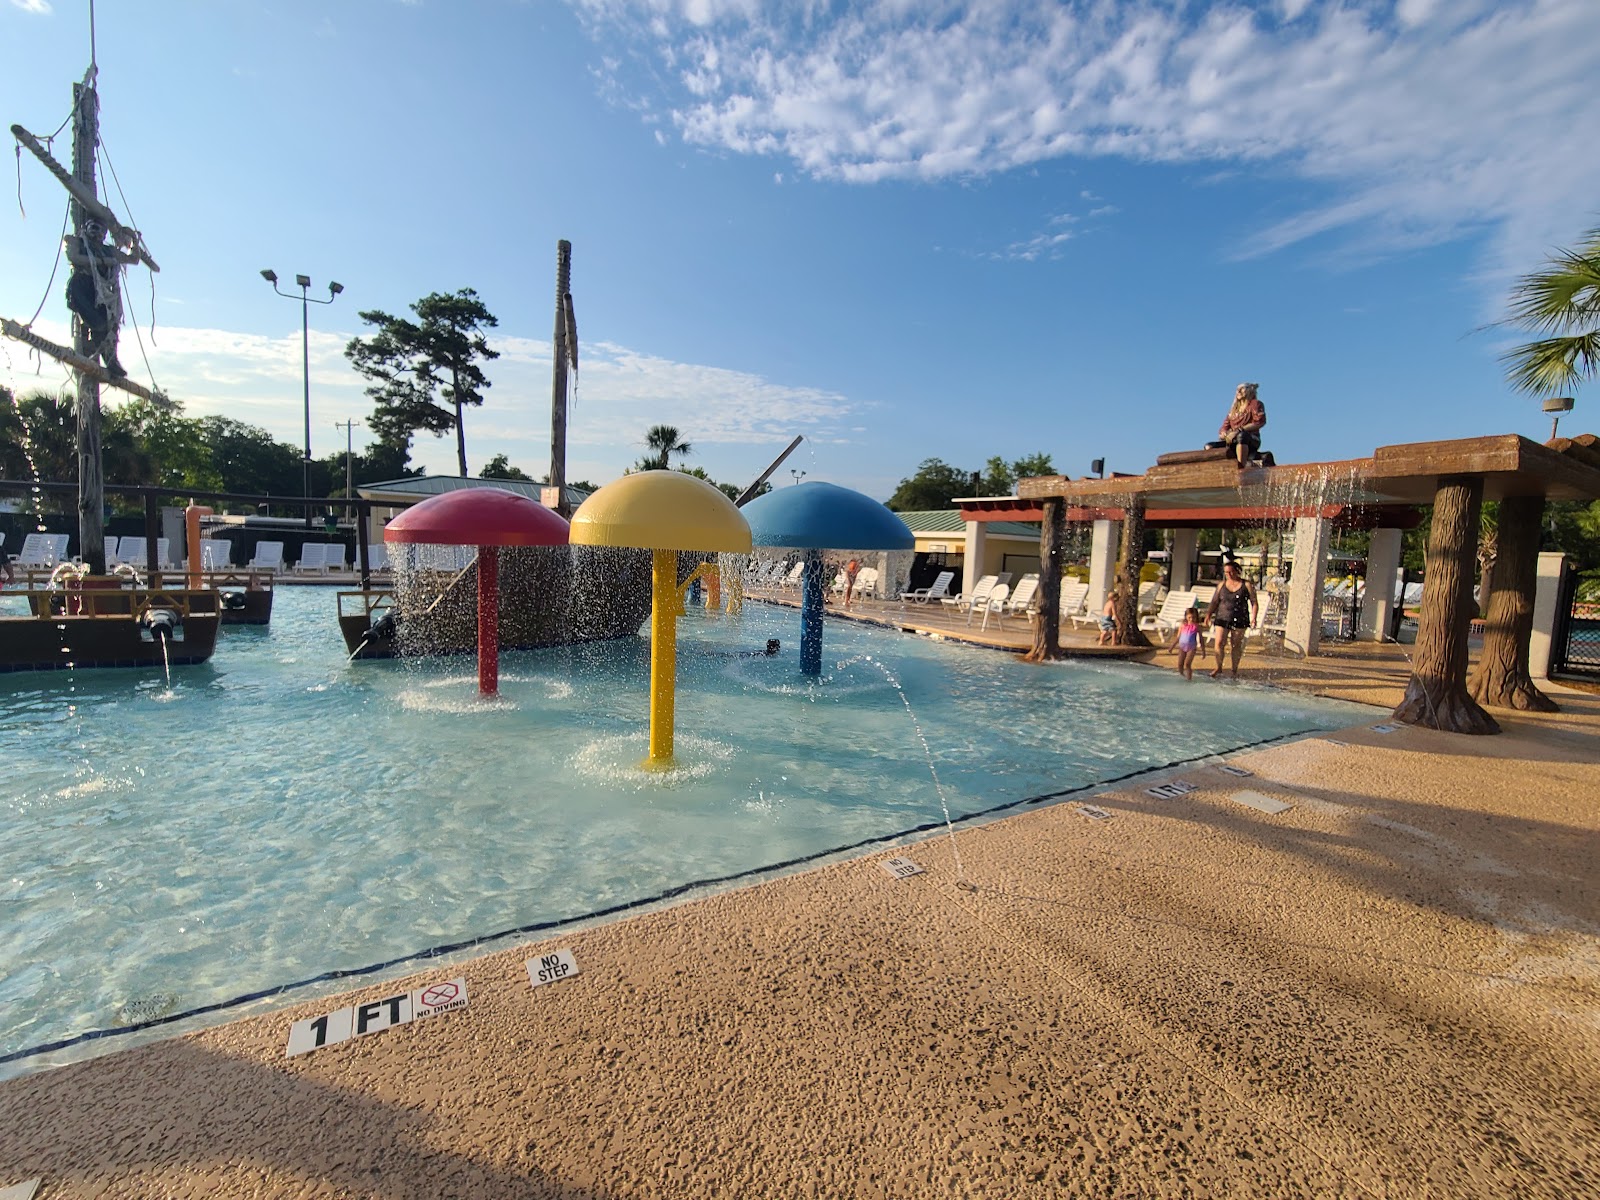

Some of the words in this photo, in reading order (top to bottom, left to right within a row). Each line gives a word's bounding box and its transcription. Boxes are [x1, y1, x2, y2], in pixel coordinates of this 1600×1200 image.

[888, 858, 903, 867] NO
[541, 954, 560, 969] NO
[538, 963, 569, 982] STEP
[416, 1010, 430, 1018] NO
[433, 999, 466, 1014] DIVING
[310, 1015, 328, 1048] 1
[357, 994, 408, 1035] FT
